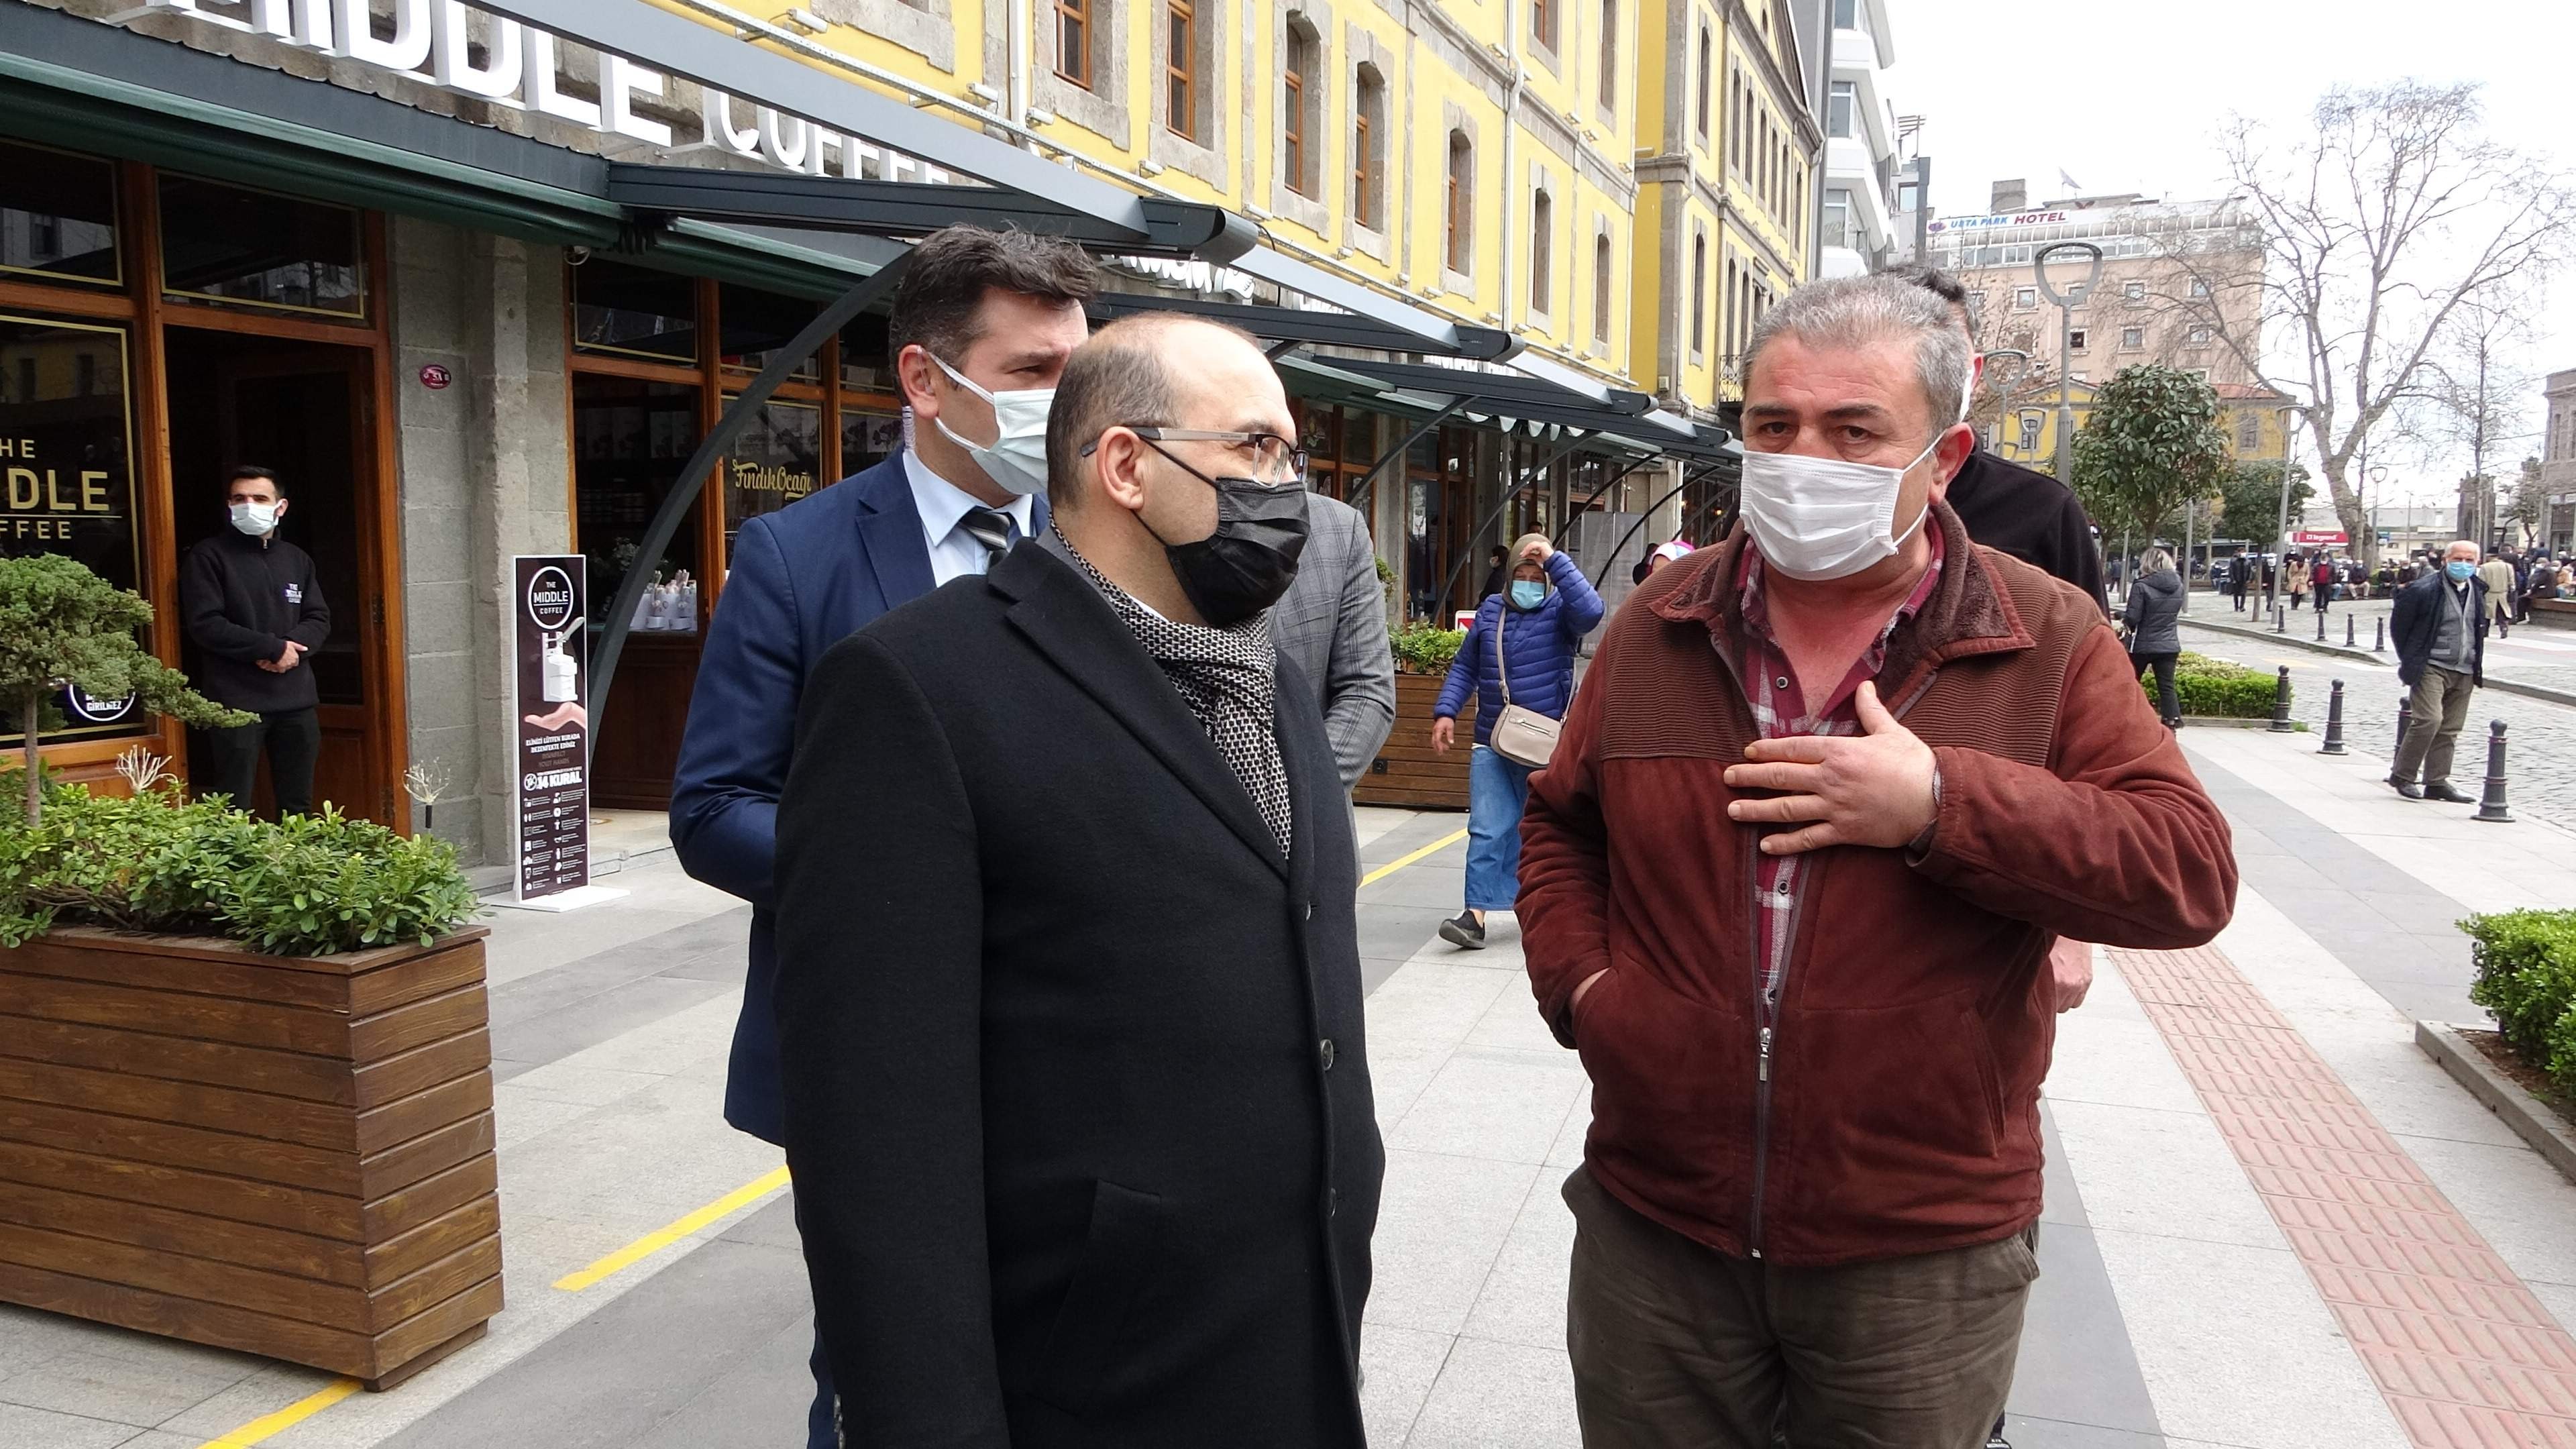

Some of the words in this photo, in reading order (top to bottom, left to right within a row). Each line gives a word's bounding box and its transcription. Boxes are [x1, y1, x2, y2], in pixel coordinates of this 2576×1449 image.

[2014, 212, 2066, 225] HOTEL
[533, 591, 568, 603] MIDDLE
[540, 606, 563, 614] COFFEE
[549, 771, 582, 788] KURAL
